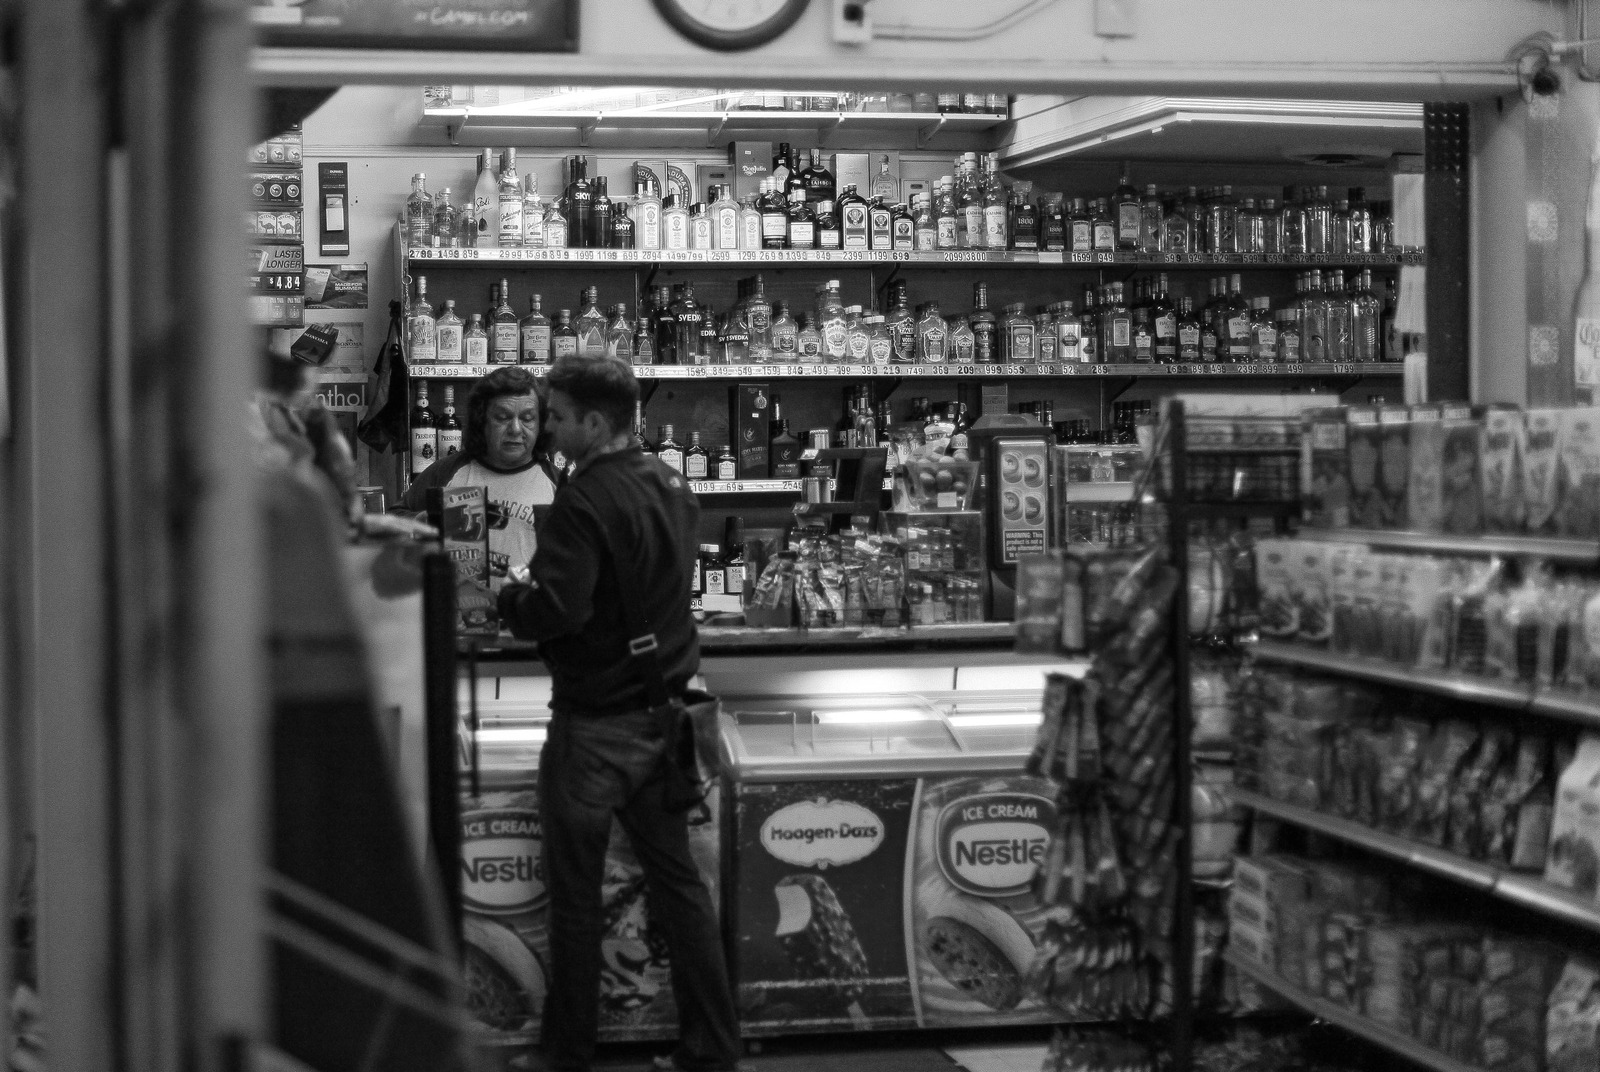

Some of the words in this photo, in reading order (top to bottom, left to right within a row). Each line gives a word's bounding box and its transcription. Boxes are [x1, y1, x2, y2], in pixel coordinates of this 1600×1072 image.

[274, 250, 301, 258] LASTS
[499, 250, 522, 259] 2999
[711, 252, 730, 260] 2599
[843, 252, 862, 260] 2399
[868, 252, 887, 260] 1199
[944, 252, 963, 261] 2099
[966, 252, 986, 261] 3800
[1072, 253, 1091, 262] 1699
[1098, 253, 1114, 262] 949
[266, 260, 301, 268] LONGER
[862, 366, 878, 375] 399
[933, 366, 949, 375] 369
[958, 366, 974, 375] 209
[985, 366, 1002, 375] 999
[1008, 366, 1025, 375] 559
[1037, 366, 1054, 375] 309
[1092, 366, 1108, 375] 289
[1237, 365, 1257, 374] 2399
[1334, 365, 1354, 374] 1799
[693, 483, 715, 491] 1099
[963, 806, 984, 821] ICE
[987, 804, 1038, 819] CREAM
[463, 820, 486, 837] ICE
[490, 820, 543, 836] CREAM
[956, 838, 1046, 867] Nestlé
